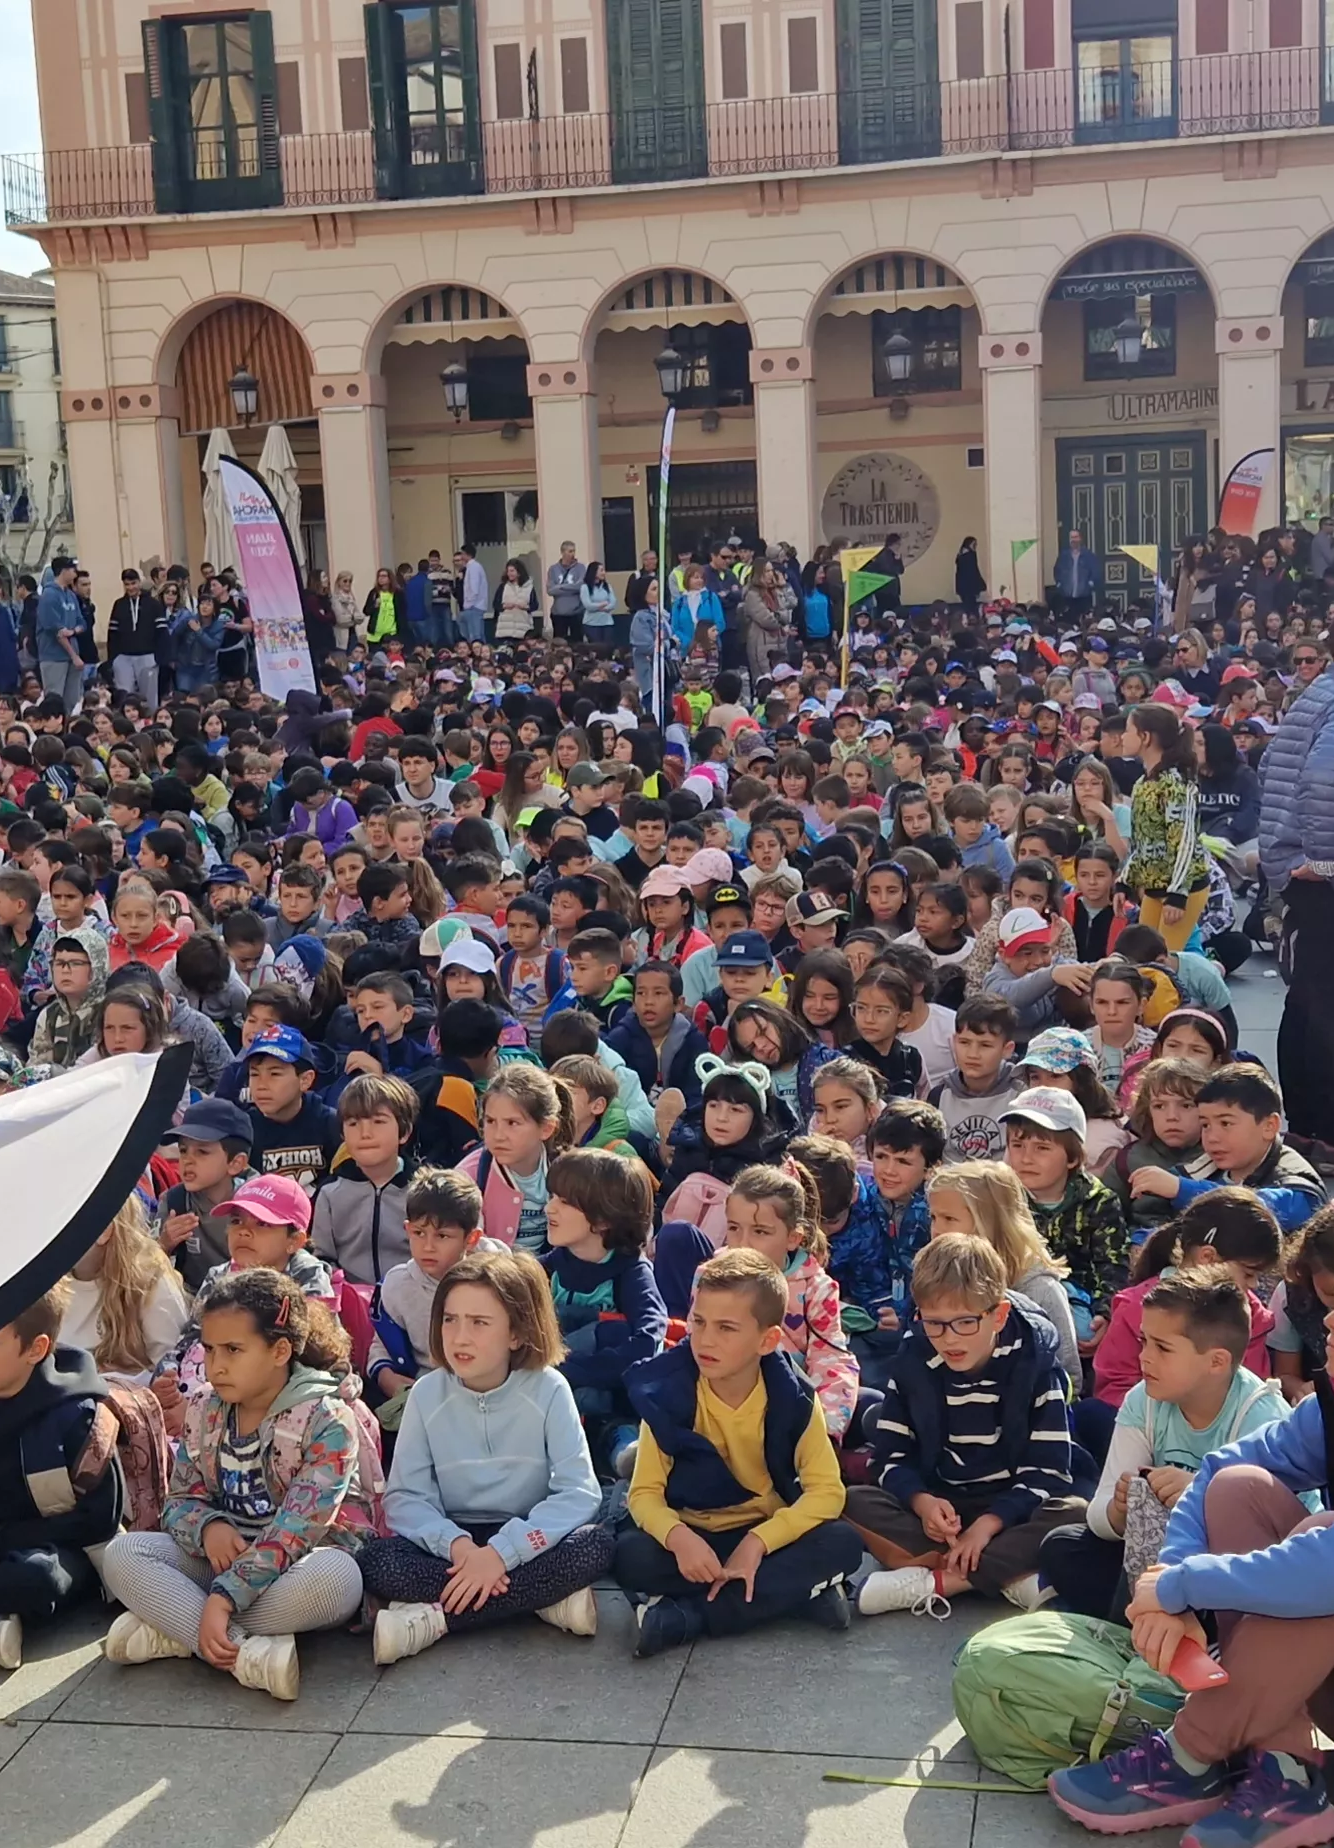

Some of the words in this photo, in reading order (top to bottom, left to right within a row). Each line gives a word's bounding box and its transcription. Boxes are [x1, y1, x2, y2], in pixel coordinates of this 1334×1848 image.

[1125, 273, 1198, 294] especialidades
[871, 478, 887, 503] LA
[839, 501, 919, 527] TRASTIENDA
[949, 1116, 1001, 1142] SEVILLA
